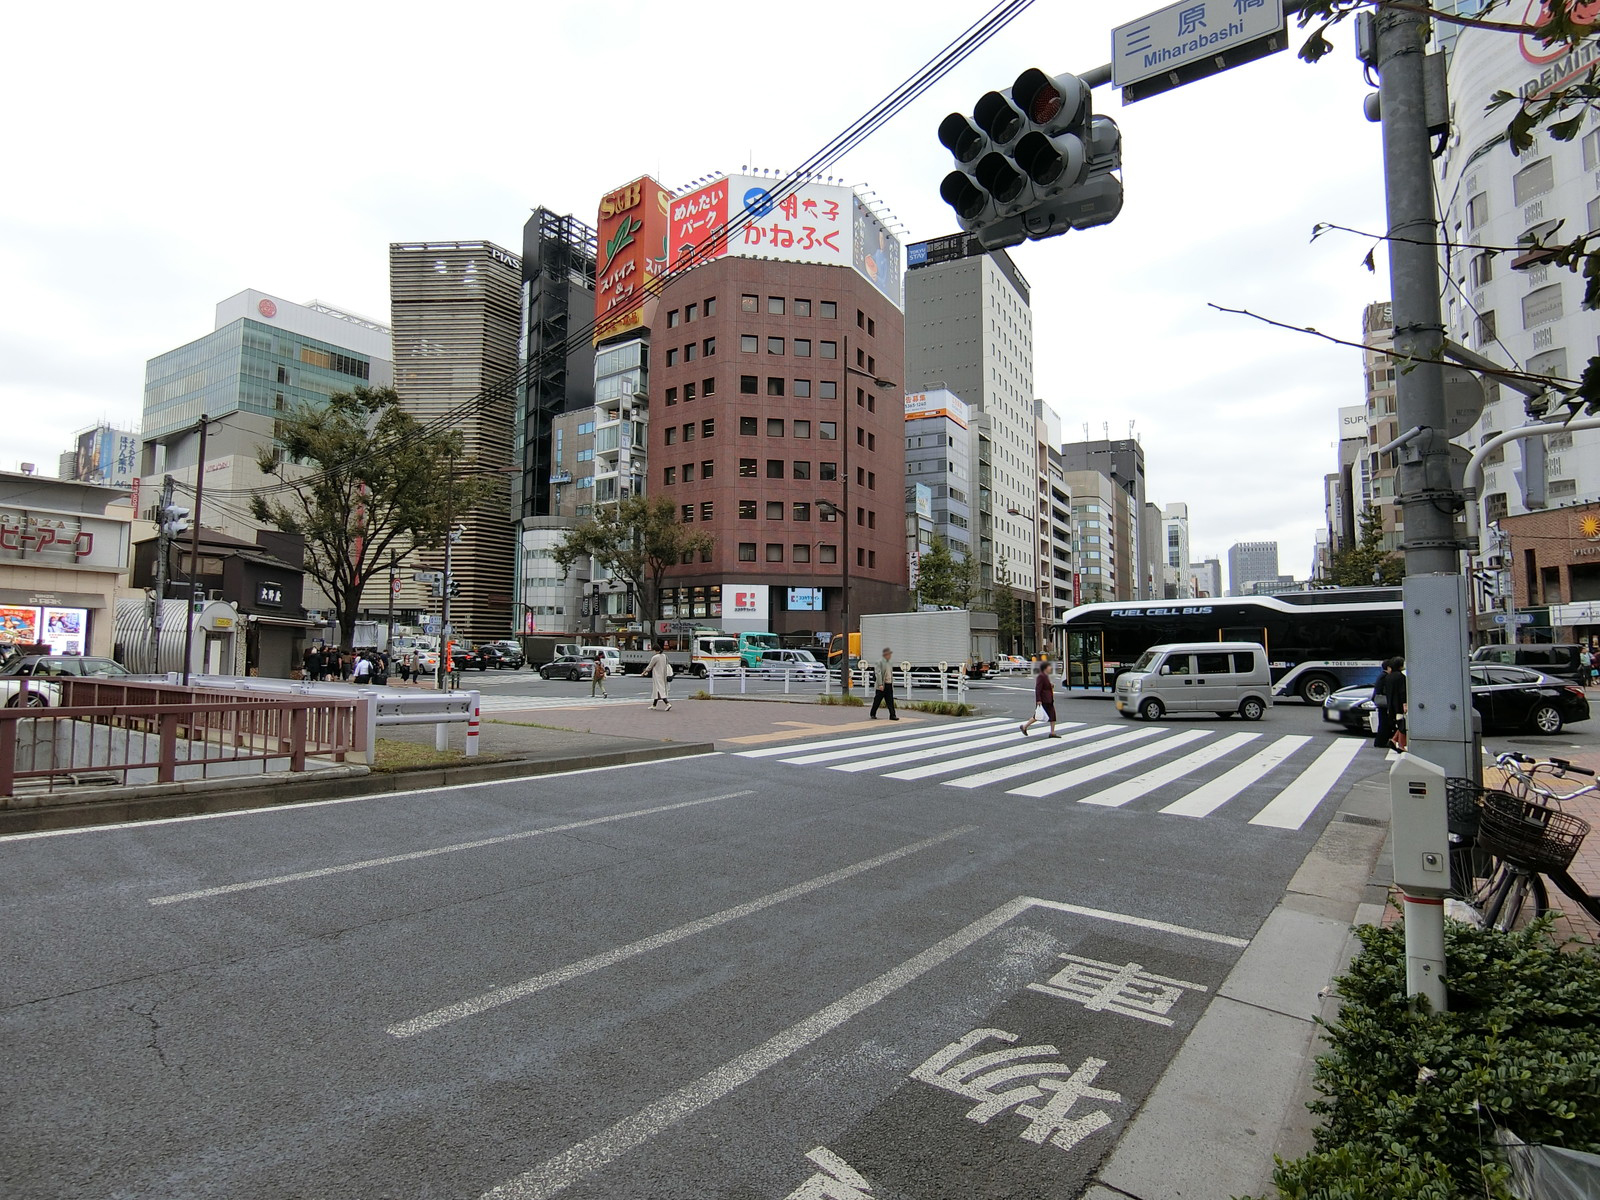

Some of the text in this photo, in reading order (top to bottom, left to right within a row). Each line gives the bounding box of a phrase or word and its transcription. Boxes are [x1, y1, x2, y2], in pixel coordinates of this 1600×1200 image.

[1144, 19, 1244, 68] Miharabashi
[1519, 38, 1600, 104] IDEMIT
[600, 182, 641, 220] S&B
[673, 189, 724, 221] めんたい
[778, 192, 840, 221] 明太子
[679, 210, 717, 238] パーク
[742, 220, 840, 253] かねふく
[492, 248, 520, 269] PIAS
[600, 259, 636, 294] スパイス
[615, 282, 624, 295] &
[2, 514, 66, 529] GINZA
[0, 524, 94, 556] ピーアーク
[1111, 606, 1213, 617] FUEL CELL BUS
